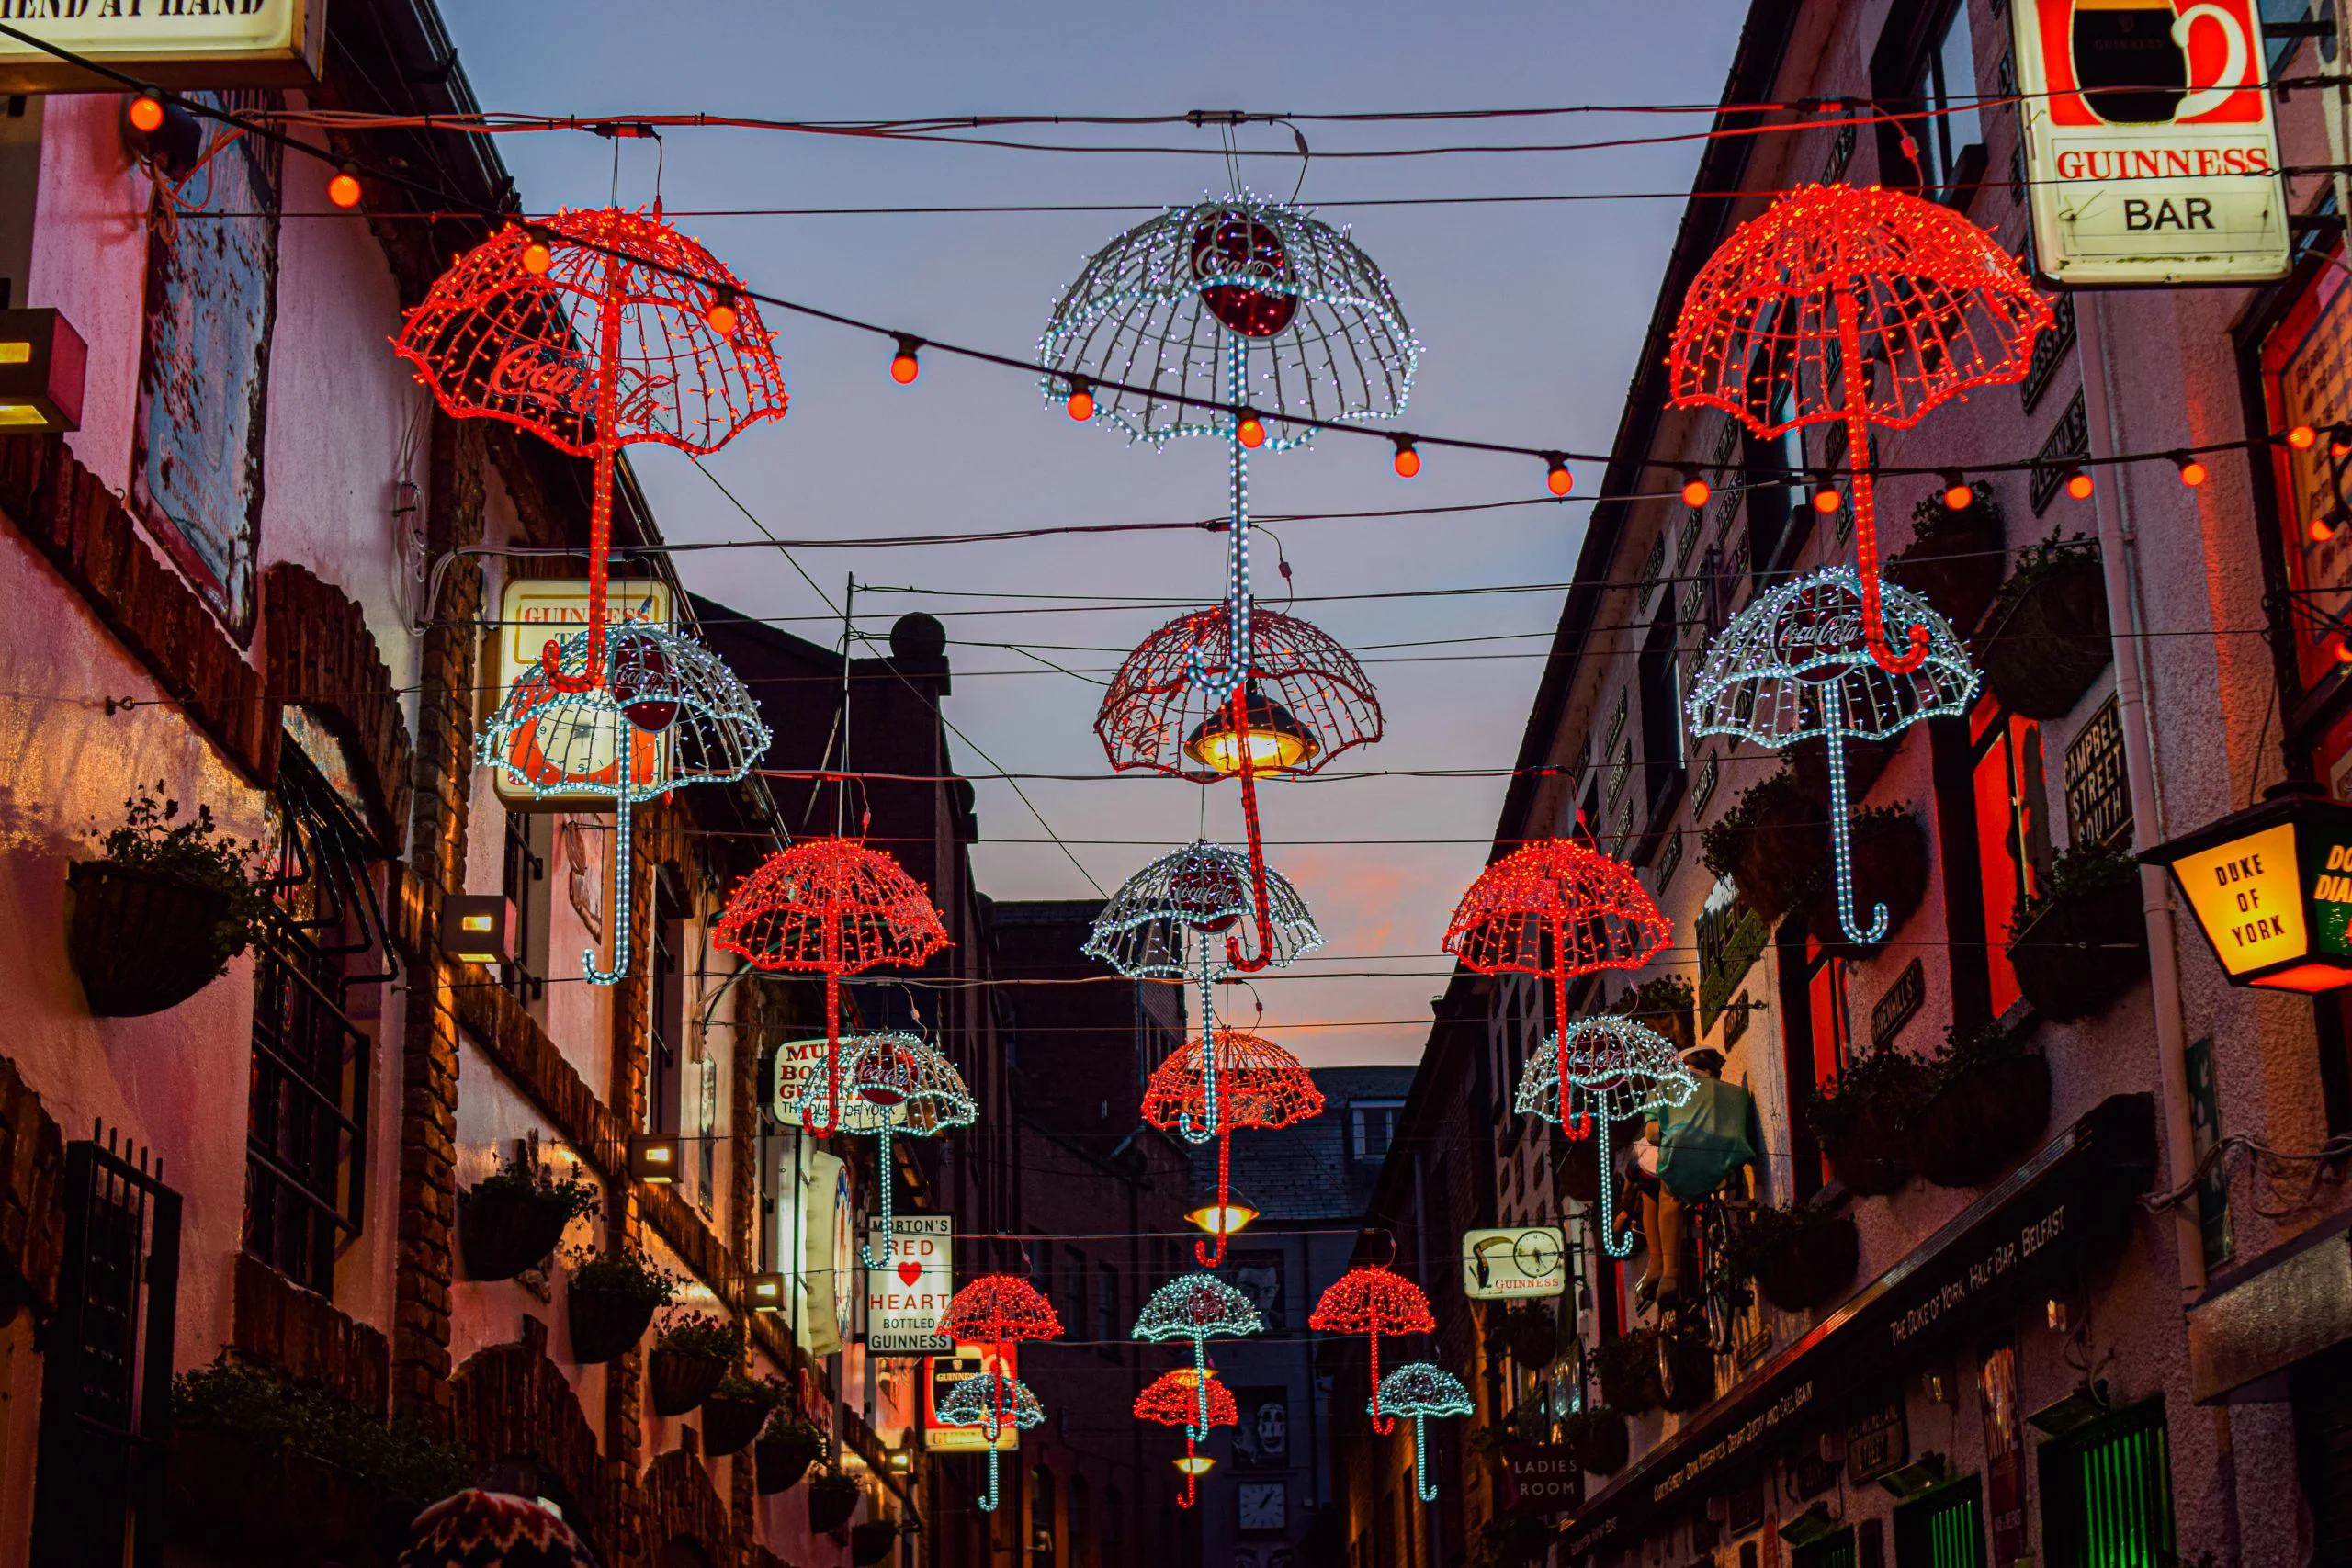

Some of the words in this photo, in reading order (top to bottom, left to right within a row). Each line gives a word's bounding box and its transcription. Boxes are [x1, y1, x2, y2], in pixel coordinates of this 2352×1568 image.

[2056, 147, 2271, 180] GUINNESS
[2123, 198, 2216, 231] BAR
[524, 606, 651, 626] GUINESS
[1779, 613, 1864, 649] Coca-Cola
[2073, 742, 2121, 823] STREET
[2214, 853, 2265, 887] DUKE
[1176, 880, 1237, 905] Coca-Cola
[2236, 888, 2260, 913] OF
[2231, 914, 2286, 948] YORK
[1495, 1279, 1559, 1290] GUINNESS
[1889, 1316, 1907, 1348] THE
[1906, 1301, 1930, 1337] DUKE
[1930, 1293, 1942, 1322] OF
[1969, 1255, 1994, 1295] HALF
[2021, 1204, 2066, 1258] BELFAST
[869, 1293, 950, 1310] HEART
[883, 1318, 935, 1329] BOTTLED
[871, 1335, 947, 1348] GUINNESS
[1514, 1459, 1578, 1474] LADIES
[1519, 1481, 1576, 1497] ROOM
